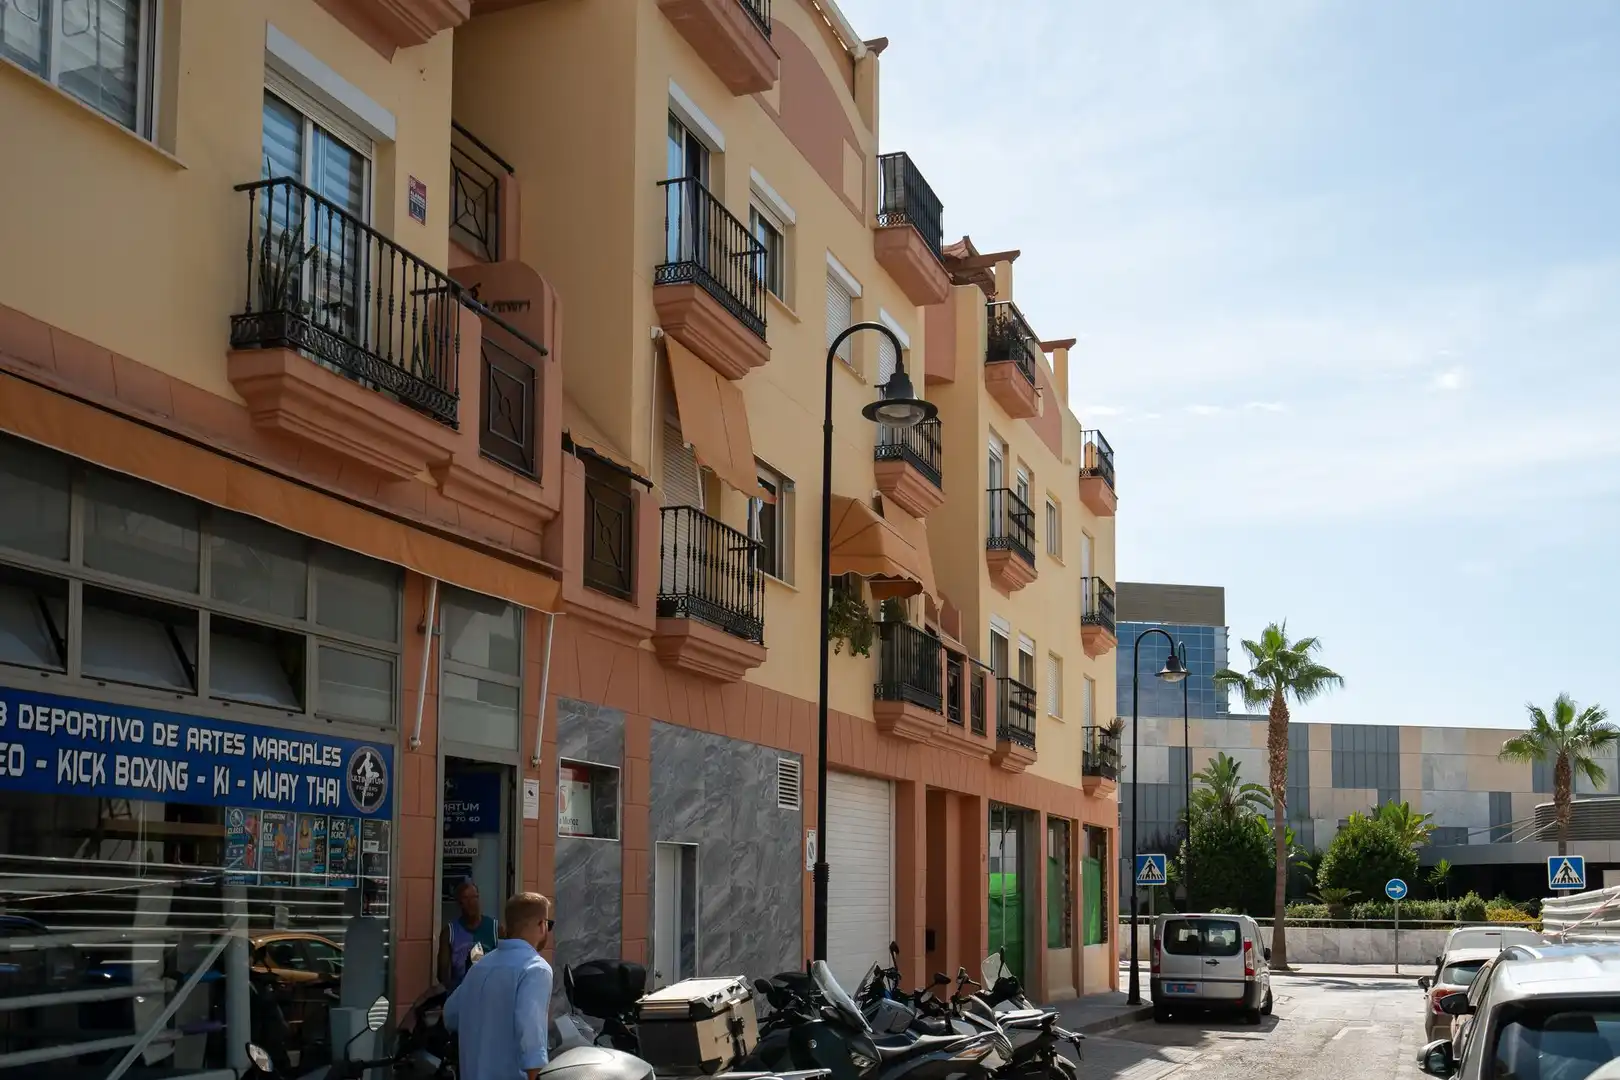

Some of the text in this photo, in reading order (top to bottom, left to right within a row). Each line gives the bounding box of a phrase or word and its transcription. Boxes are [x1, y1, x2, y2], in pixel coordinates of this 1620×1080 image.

[18, 703, 144, 743] DEPORTIVO
[152, 722, 180, 747] DE
[186, 727, 247, 755] ARTES
[253, 735, 342, 767] MARCIALES
[57, 748, 106, 787] KICK
[115, 754, 189, 793] BOXING
[252, 767, 299, 804] MUAY
[306, 775, 340, 808] THAI
